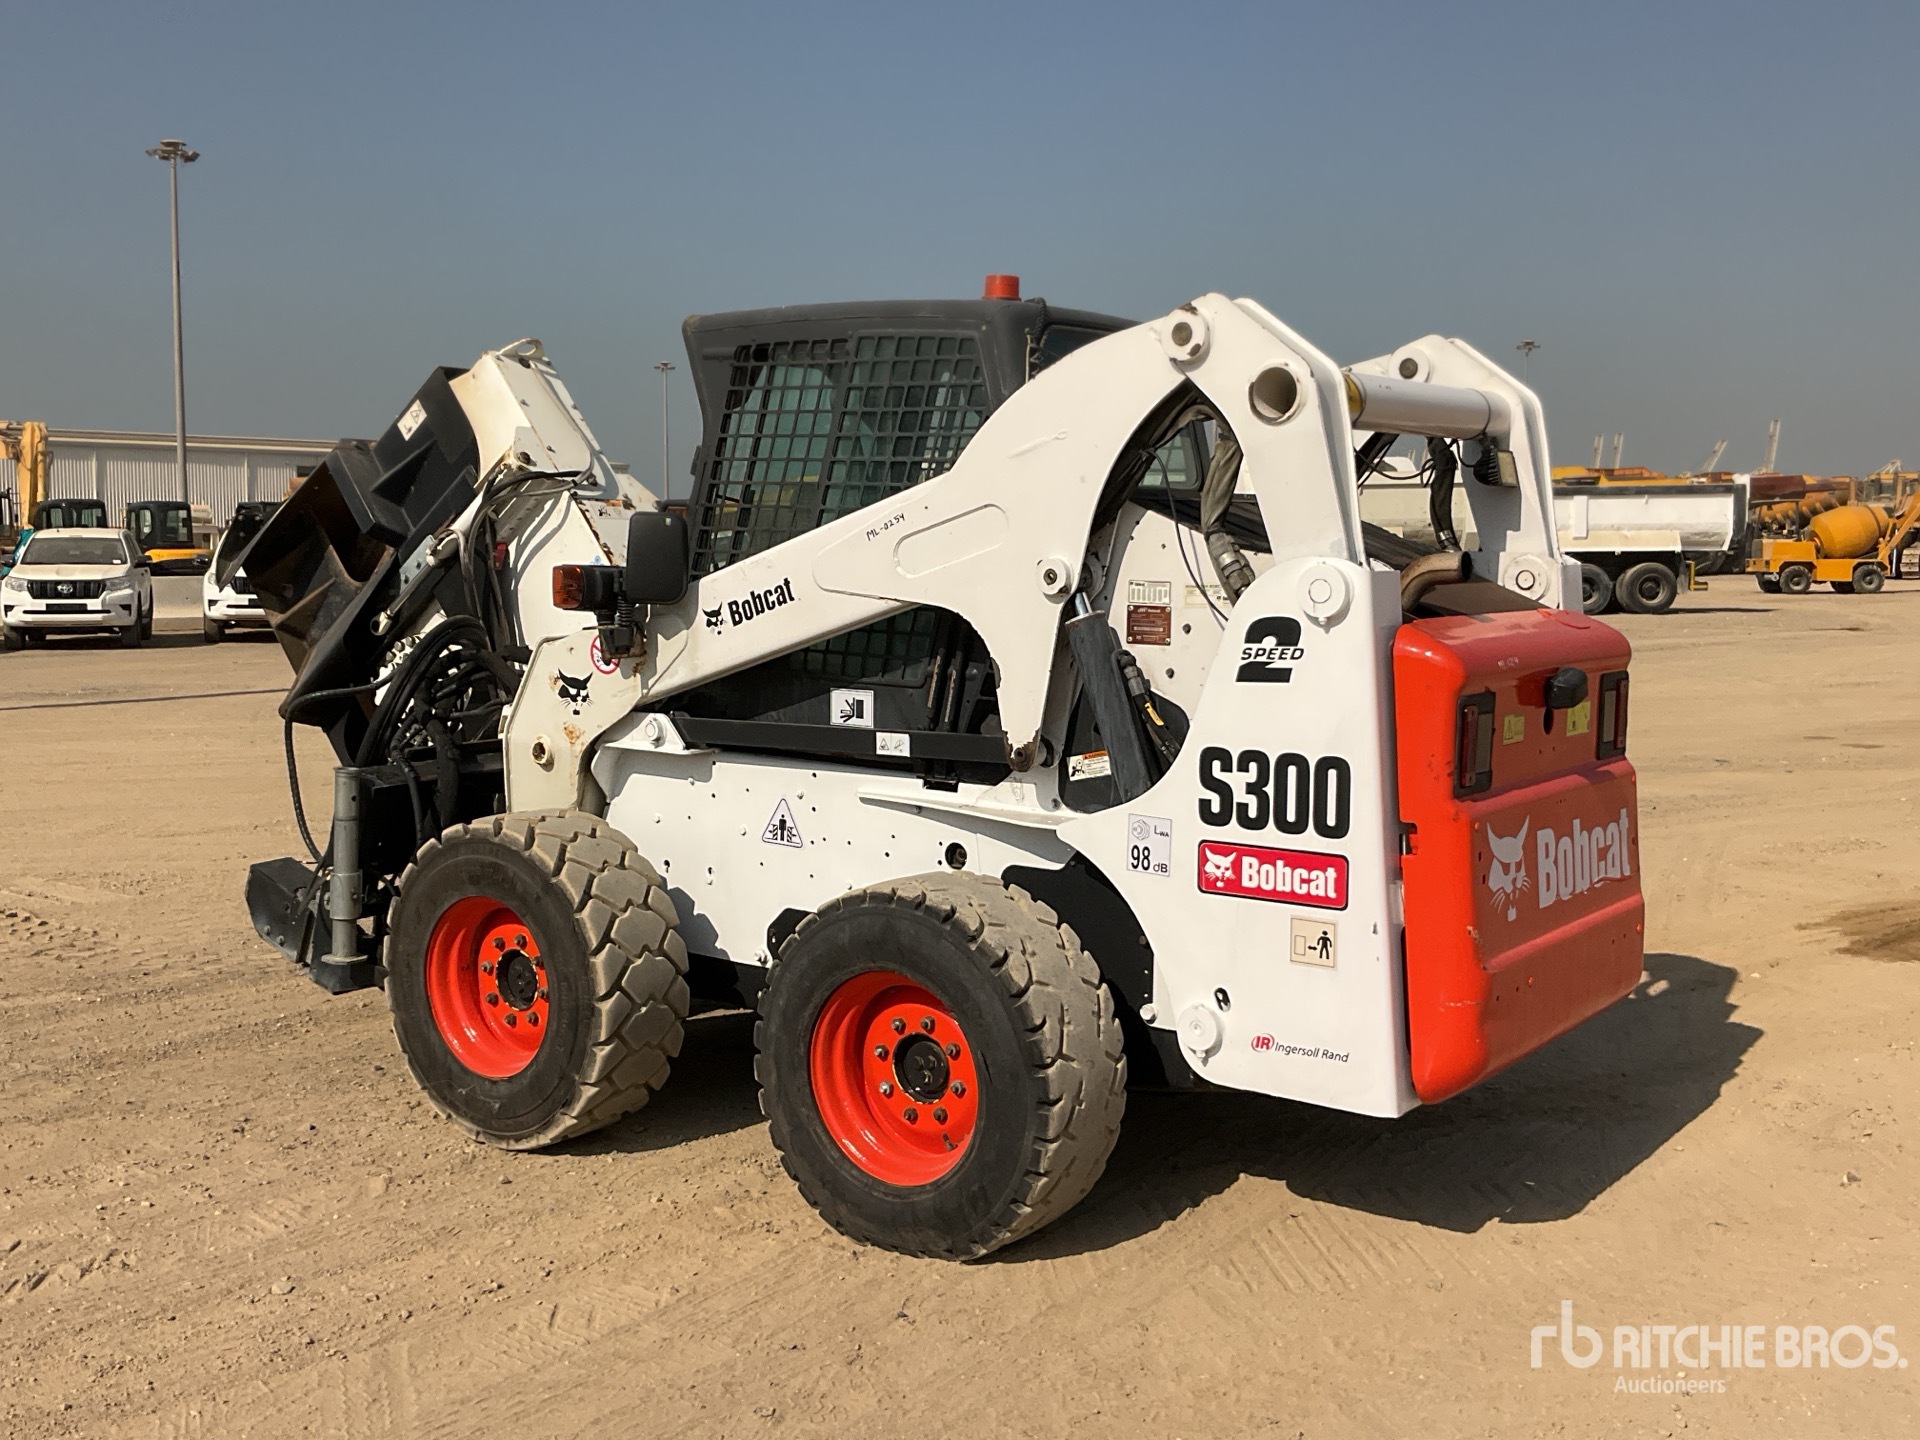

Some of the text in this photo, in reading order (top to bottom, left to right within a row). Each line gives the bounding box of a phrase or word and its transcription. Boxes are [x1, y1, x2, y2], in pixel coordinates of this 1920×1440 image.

[866, 513, 905, 541] ML-0254
[727, 577, 795, 627] Bobcat
[1235, 616, 1302, 683] 2
[1241, 647, 1304, 660] SPEED
[1198, 746, 1350, 839] S300
[1131, 844, 1168, 873] 98 dB
[1241, 856, 1337, 899] Bobcat
[1537, 808, 1630, 909] Bobcat
[1254, 1035, 1350, 1063] IR Ingersoll Rand
